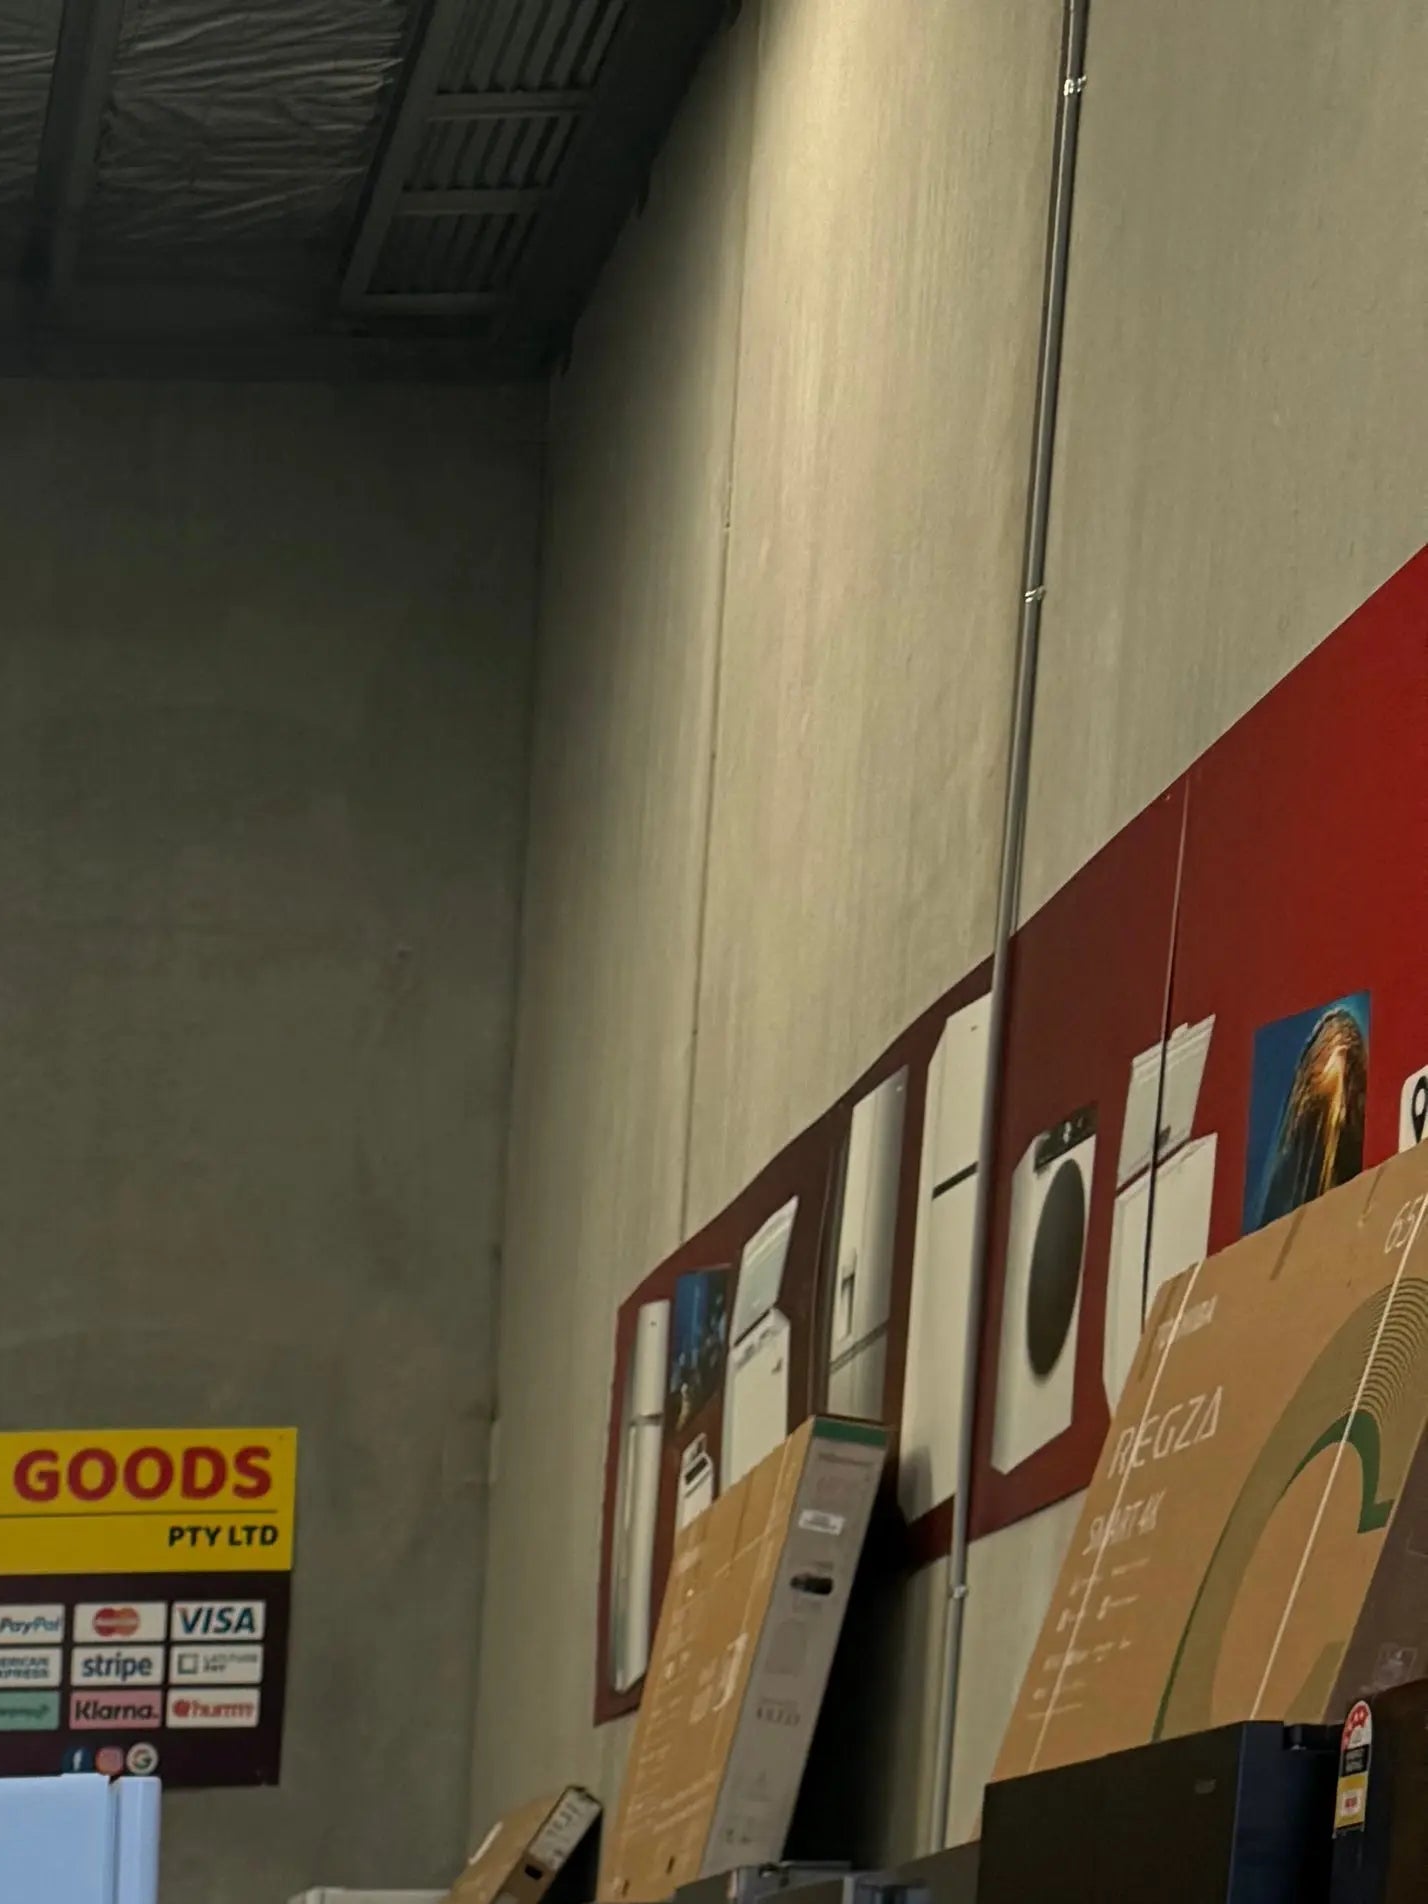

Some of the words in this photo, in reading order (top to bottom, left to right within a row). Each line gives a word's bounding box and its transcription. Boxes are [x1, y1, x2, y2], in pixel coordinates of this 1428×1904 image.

[13, 1446, 272, 1502] GOODS
[168, 1526, 220, 1547] PTY
[229, 1524, 278, 1546] LTD
[0, 1617, 62, 1634] PayPal
[178, 1607, 256, 1634] VISA
[83, 1652, 153, 1680] stripe
[75, 1699, 159, 1721] Klarna.
